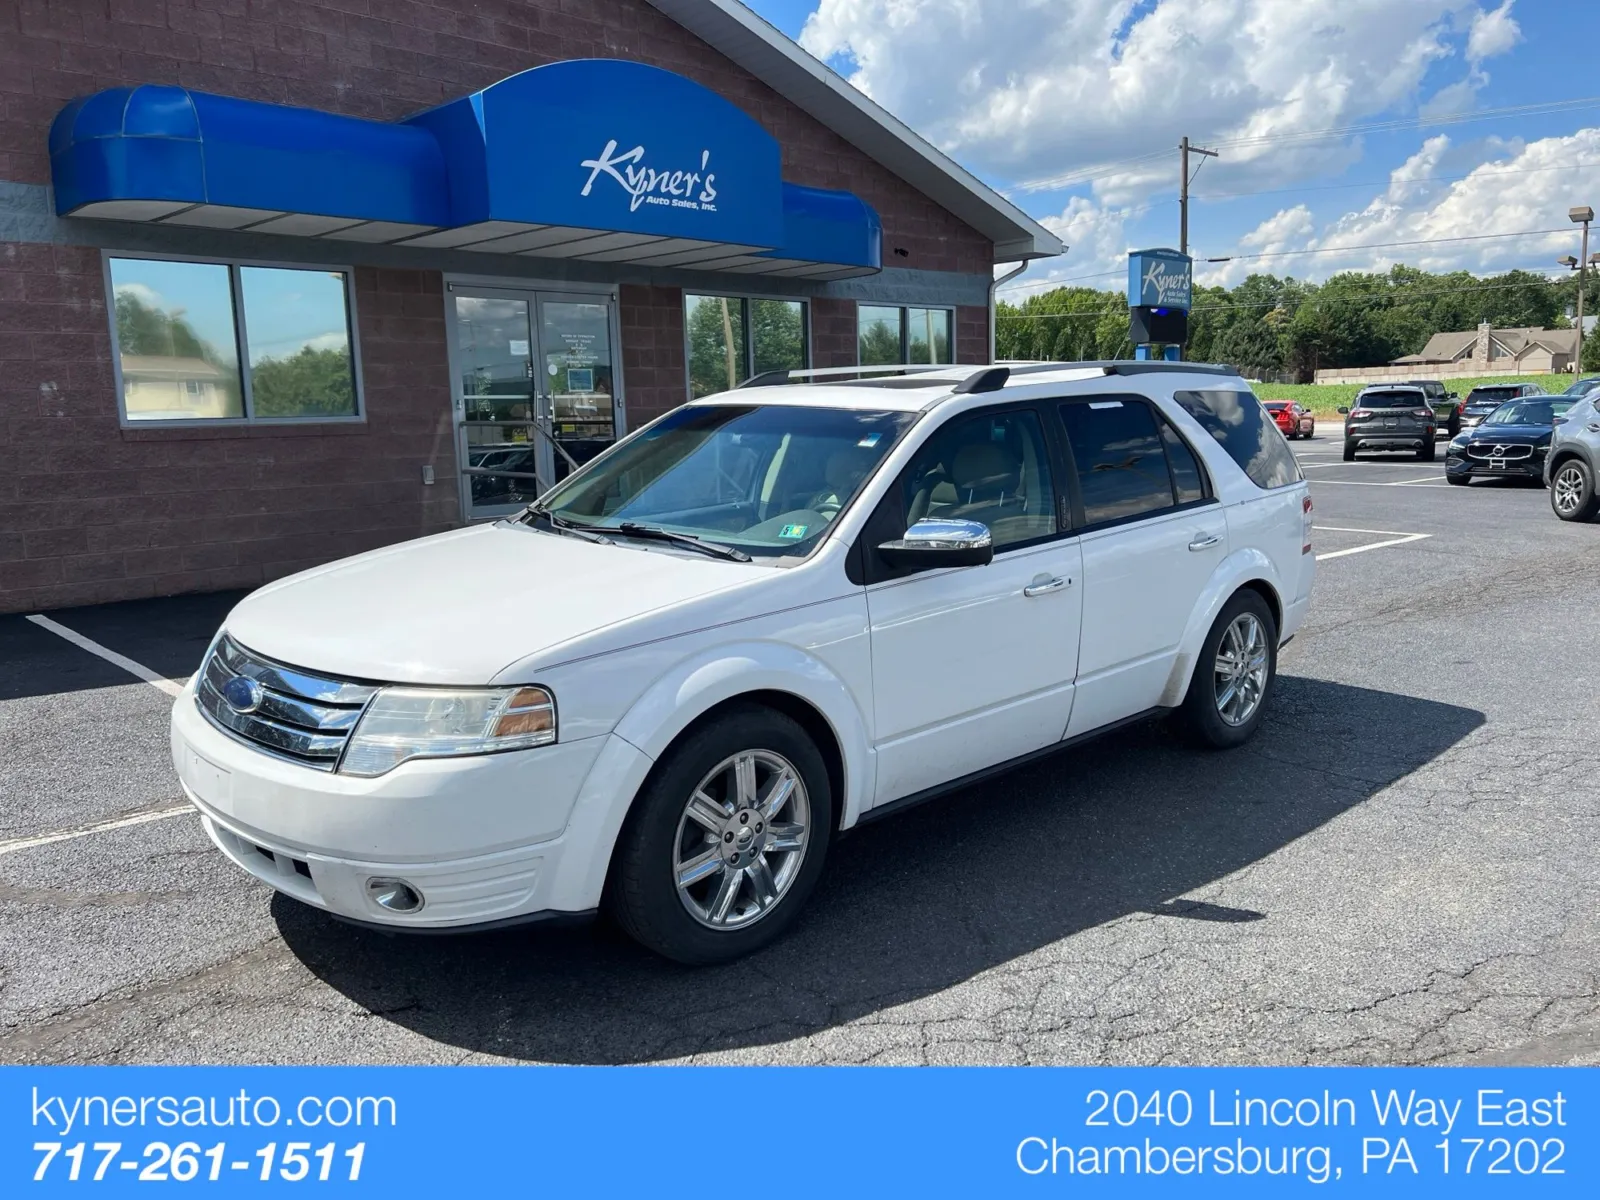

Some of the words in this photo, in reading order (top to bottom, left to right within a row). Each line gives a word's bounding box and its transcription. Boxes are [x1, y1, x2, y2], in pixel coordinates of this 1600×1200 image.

[580, 139, 717, 212] Kyner's
[646, 195, 670, 206] Auto
[671, 199, 699, 210] Sales,
[701, 203, 717, 212] Inc.
[1142, 260, 1190, 305] Kyner's
